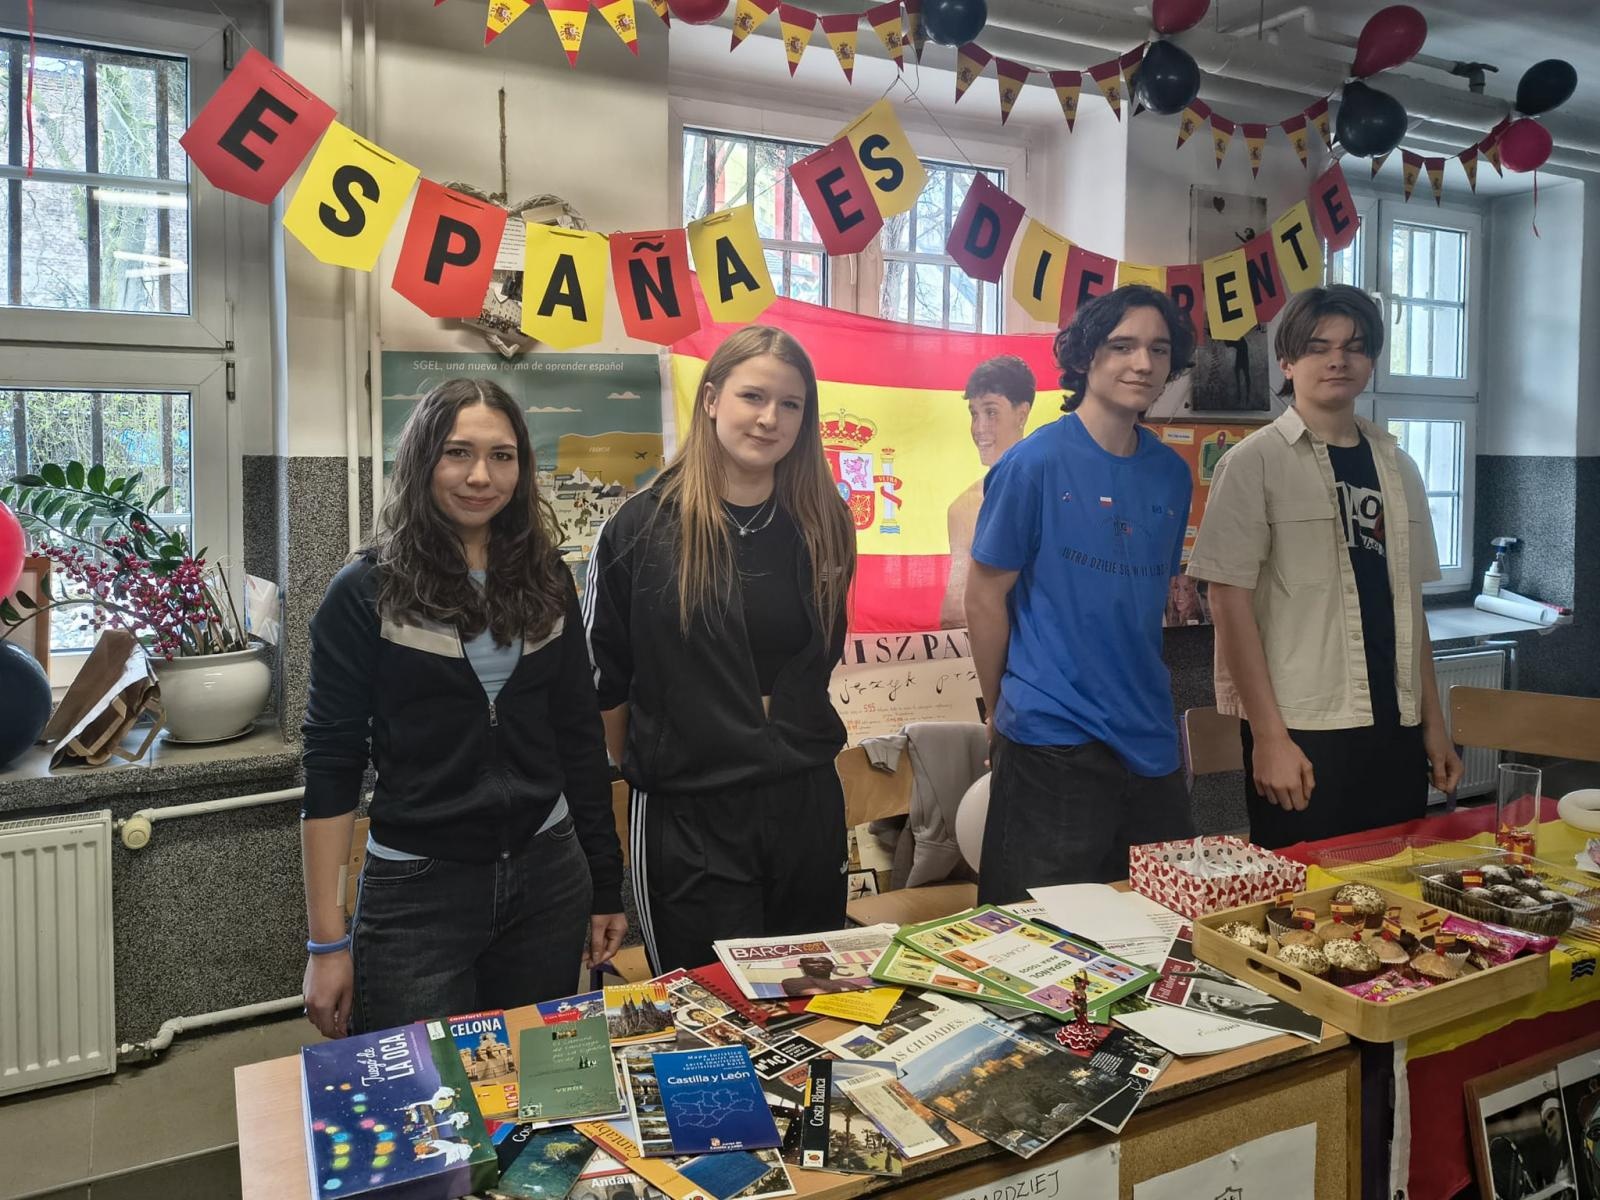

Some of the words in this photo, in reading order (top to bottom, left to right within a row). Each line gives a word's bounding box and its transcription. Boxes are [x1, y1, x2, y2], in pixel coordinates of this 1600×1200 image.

[816, 135, 904, 233] ES
[217, 87, 760, 323] ESPAÑA
[963, 184, 1351, 323] DIFRENTE
[412, 360, 443, 371] SGEL,
[446, 362, 466, 371] una
[467, 362, 497, 371] nueva
[500, 361, 529, 371] forma
[531, 361, 543, 371] de
[545, 361, 588, 373] aprender
[589, 361, 624, 373] español
[841, 631, 973, 665] ISZPA
[731, 944, 803, 958] BARÇA
[379, 1033, 410, 1060] OCA
[385, 1059, 416, 1080] LA
[667, 1074, 710, 1085] Castilla
[711, 1073, 718, 1083] y
[721, 1070, 751, 1081] León
[811, 1078, 826, 1103] Blanca
